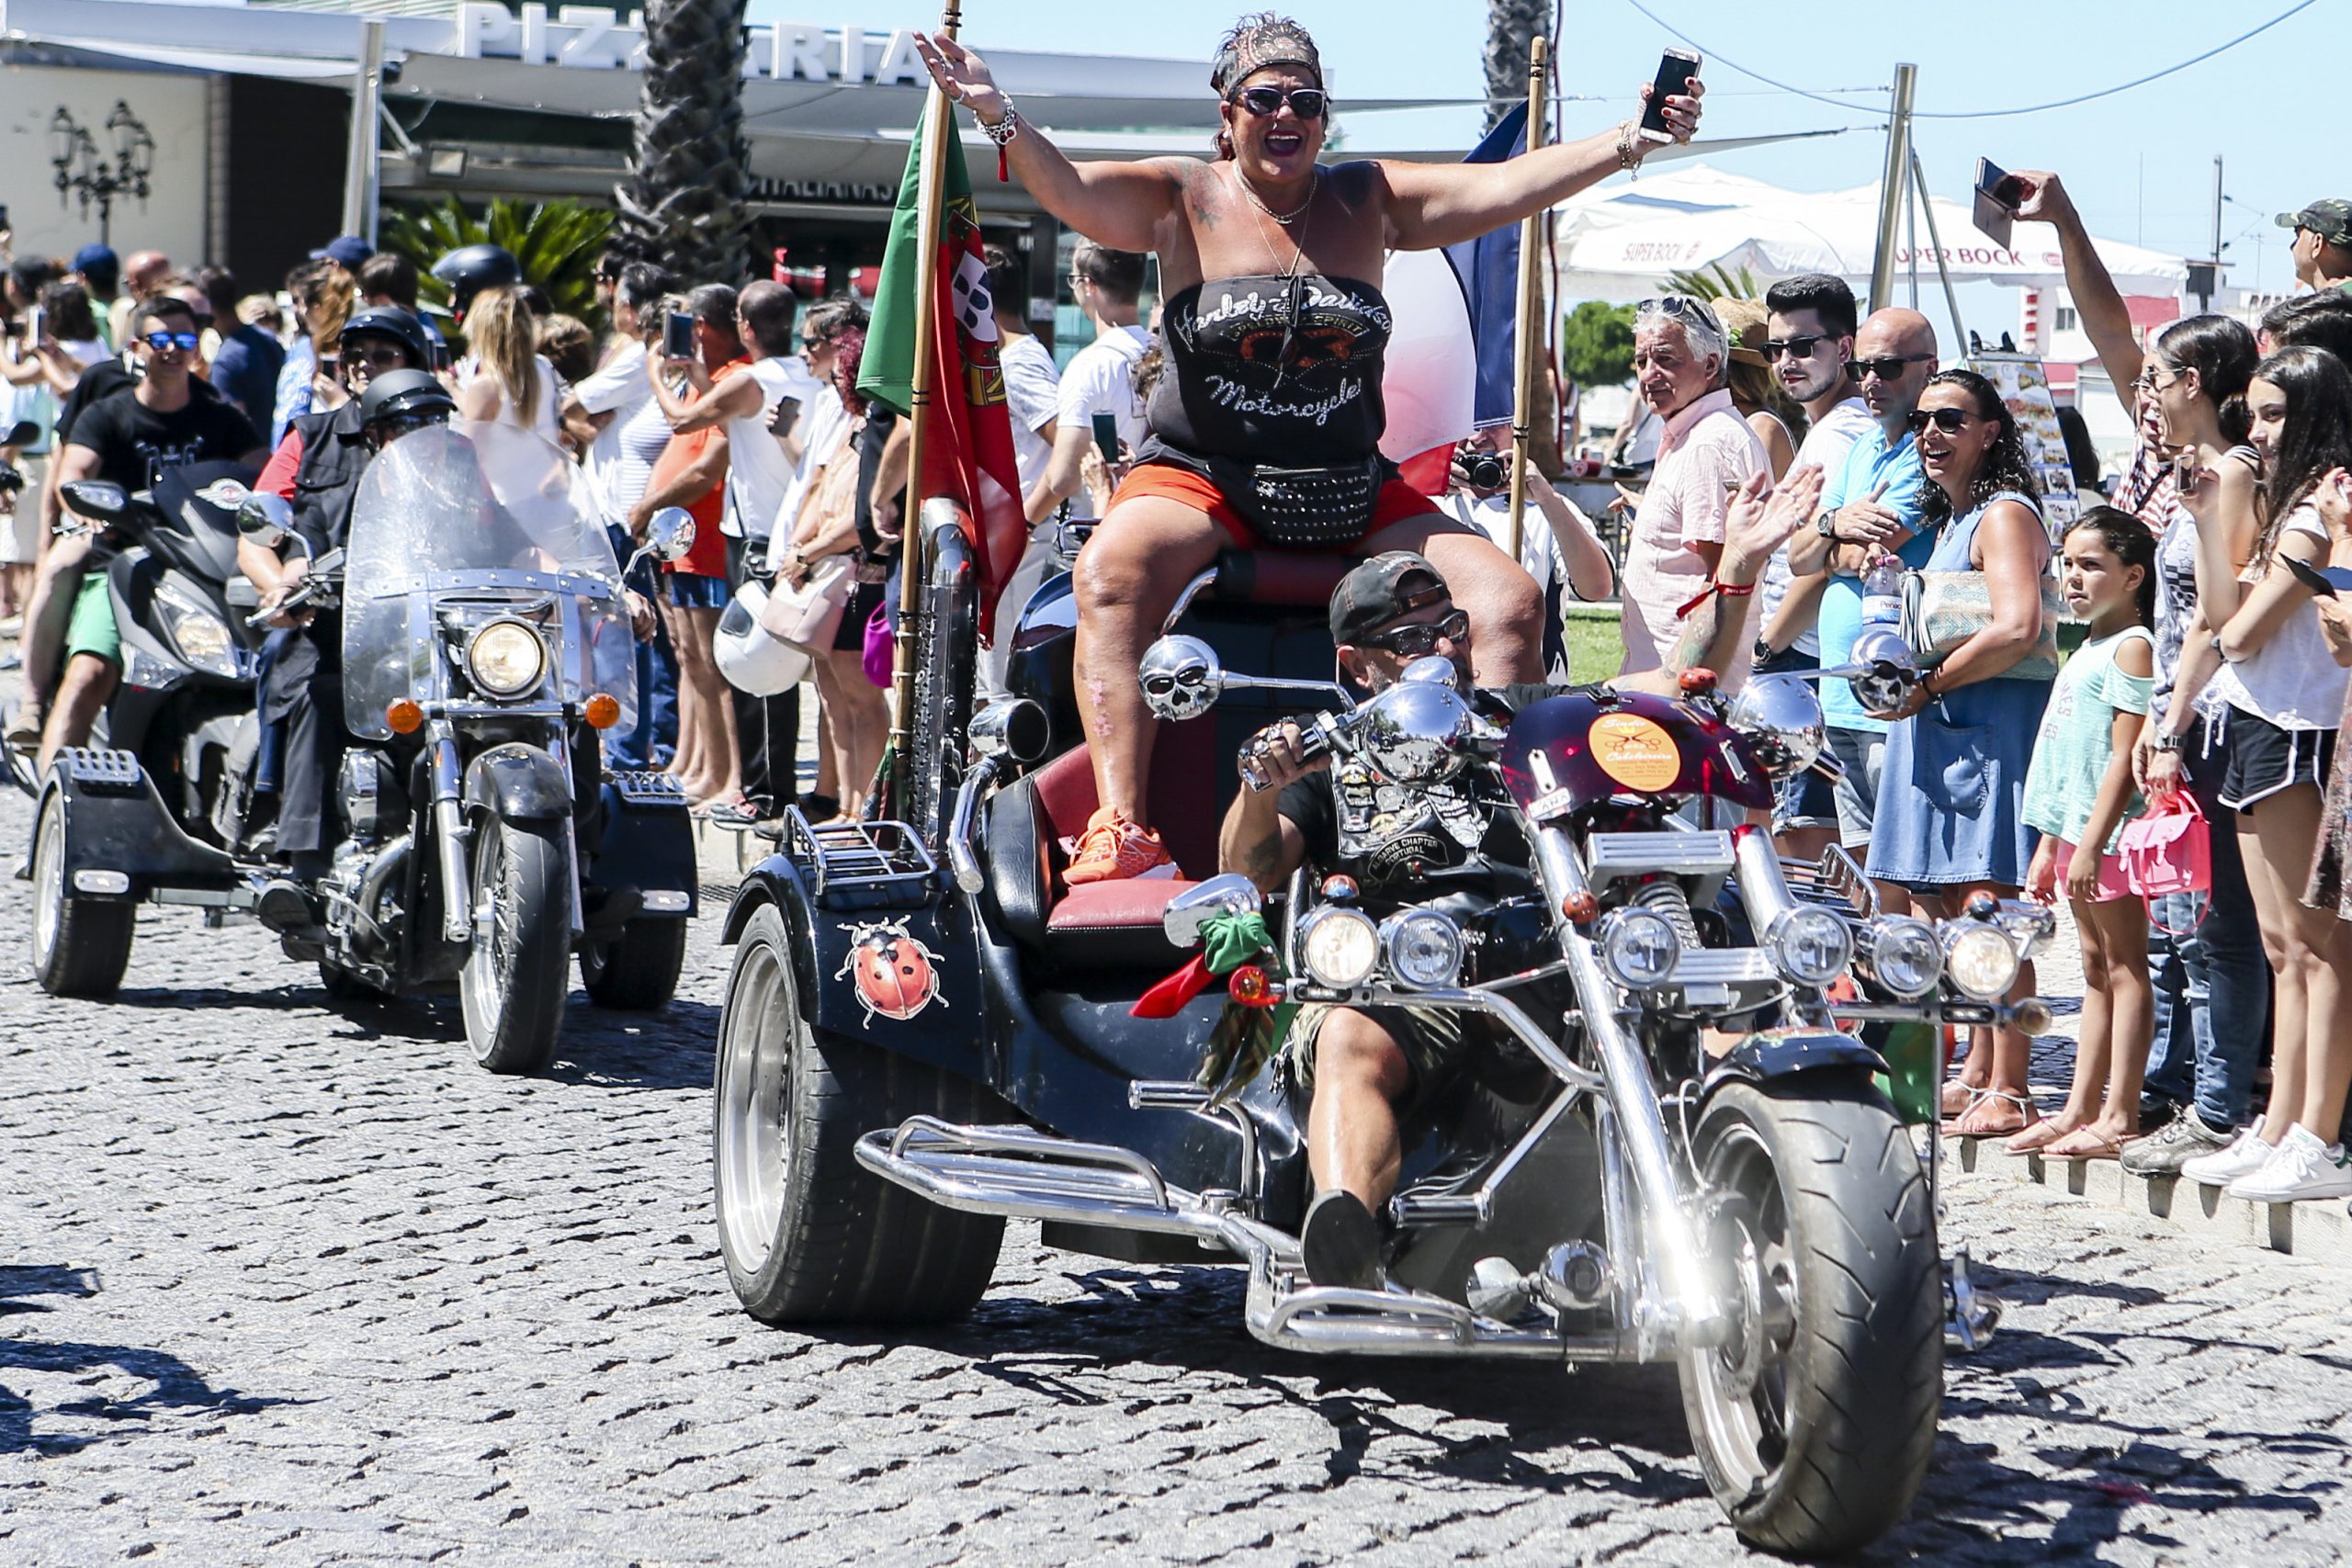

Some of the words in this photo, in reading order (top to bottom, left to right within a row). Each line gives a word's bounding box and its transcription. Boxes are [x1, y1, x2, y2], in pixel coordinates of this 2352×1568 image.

[458, 0, 930, 87] PIZRIA
[1895, 248, 1953, 265] UPER
[1958, 248, 2026, 266] BOCK
[1401, 837, 1439, 848] CHAPTER
[1385, 845, 1425, 866] PORTUGAL
